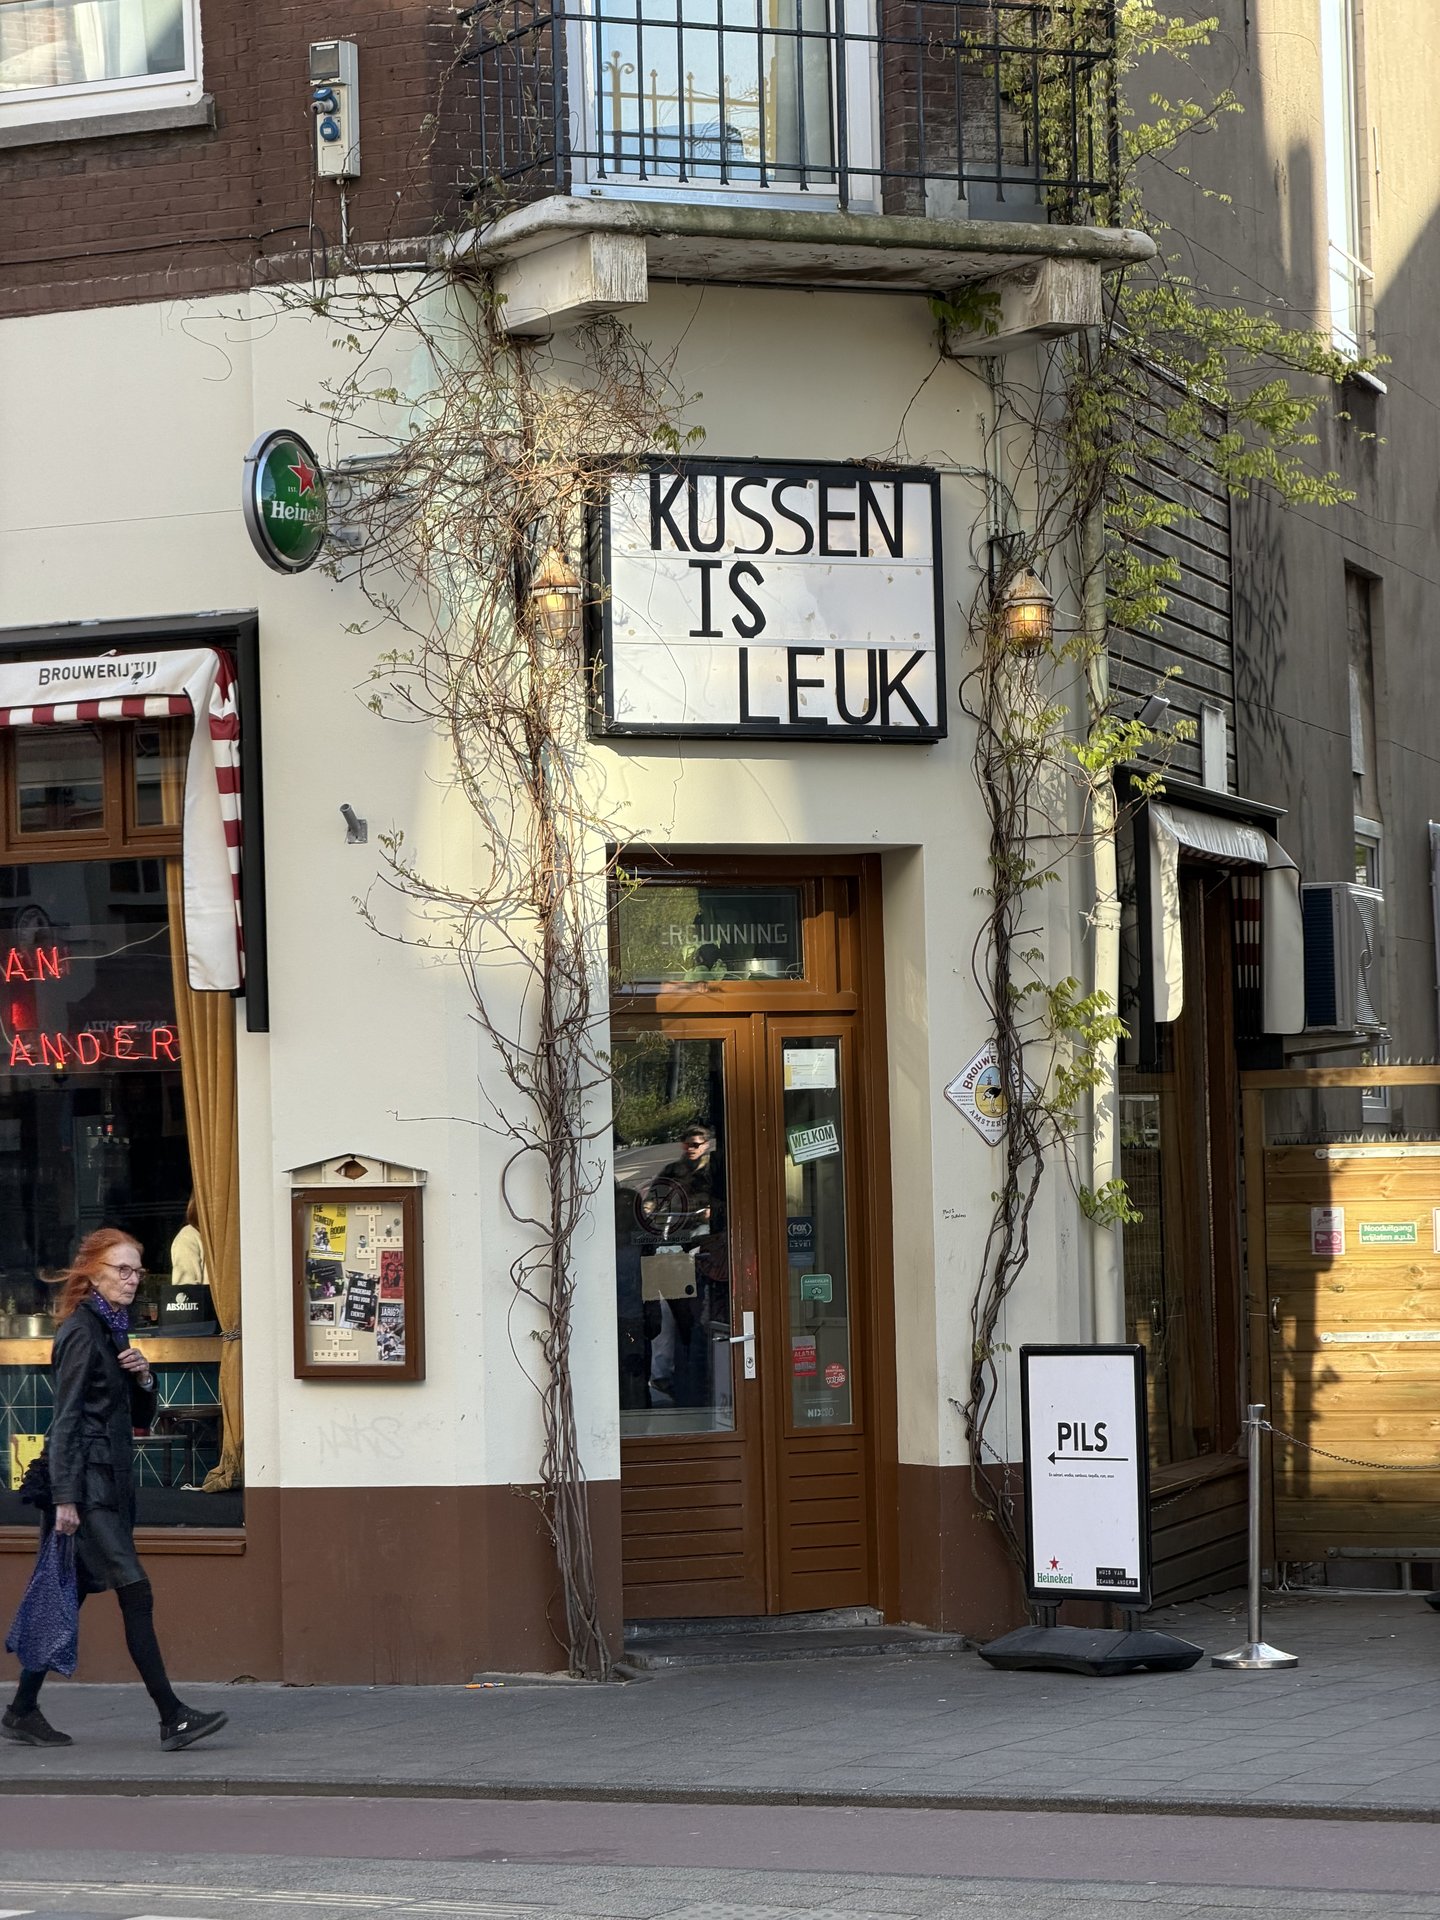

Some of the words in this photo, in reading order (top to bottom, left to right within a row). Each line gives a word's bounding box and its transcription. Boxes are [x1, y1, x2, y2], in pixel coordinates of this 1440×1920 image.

[650, 473, 903, 558] KUSSEN
[689, 560, 766, 638] IS
[39, 663, 130, 686] BROUWERIJ
[739, 647, 928, 726] LEUK
[791, 1125, 835, 1149] WELKOM
[313, 1213, 335, 1227] COMEDY
[1363, 1225, 1413, 1233] Nooduitgang
[330, 1225, 346, 1235] ROOM
[1362, 1233, 1393, 1242] vrijlaten
[166, 1302, 199, 1311] ABSOLUT.
[1057, 1422, 1108, 1452] PILS
[1036, 1572, 1073, 1585] Heineken
